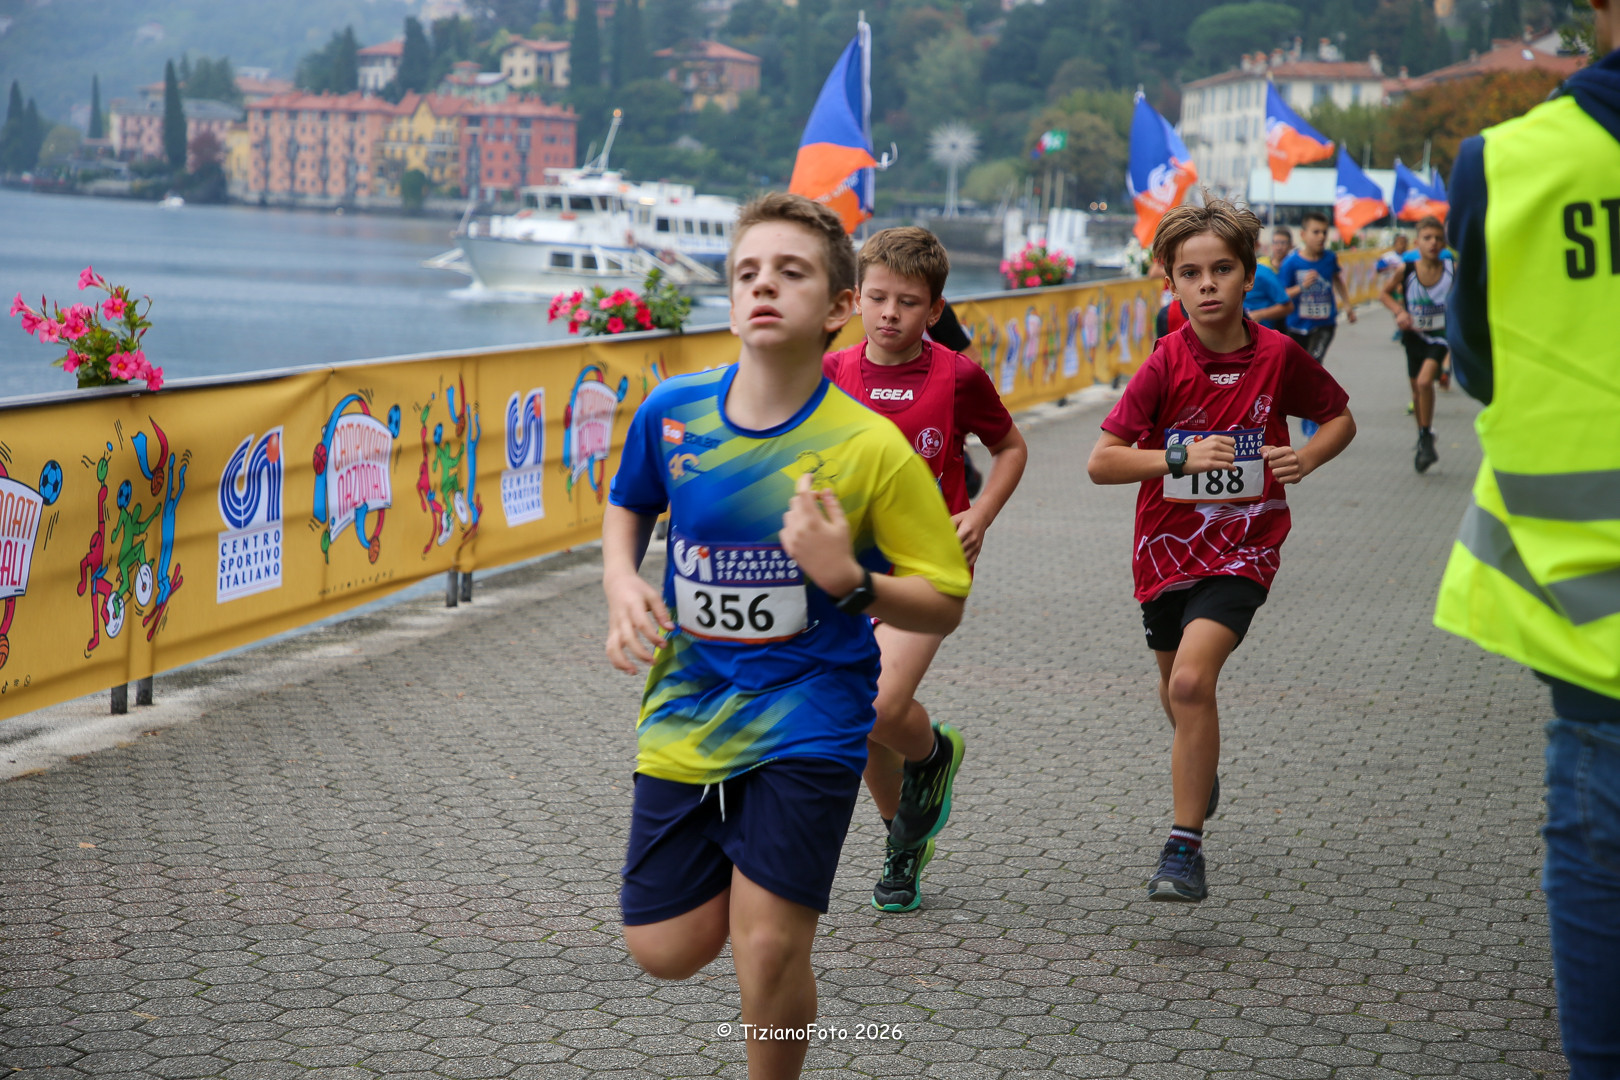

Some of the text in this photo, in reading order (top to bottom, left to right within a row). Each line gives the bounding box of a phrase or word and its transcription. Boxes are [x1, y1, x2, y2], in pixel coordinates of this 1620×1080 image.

[1210, 373, 1245, 385] EGE
[867, 388, 914, 400] EGEA
[1230, 433, 1263, 442] TRO
[1234, 440, 1263, 449] TIVO
[1235, 448, 1262, 456] IANO
[1192, 466, 1244, 495] 188
[221, 529, 280, 557] CENTRO
[220, 546, 280, 574] SPORTIVO
[715, 550, 790, 560] CENTR
[716, 559, 798, 571] SPORTIVO
[219, 562, 280, 591] ITALIANO
[717, 569, 799, 581] ITALIANO
[695, 590, 775, 632] 356
